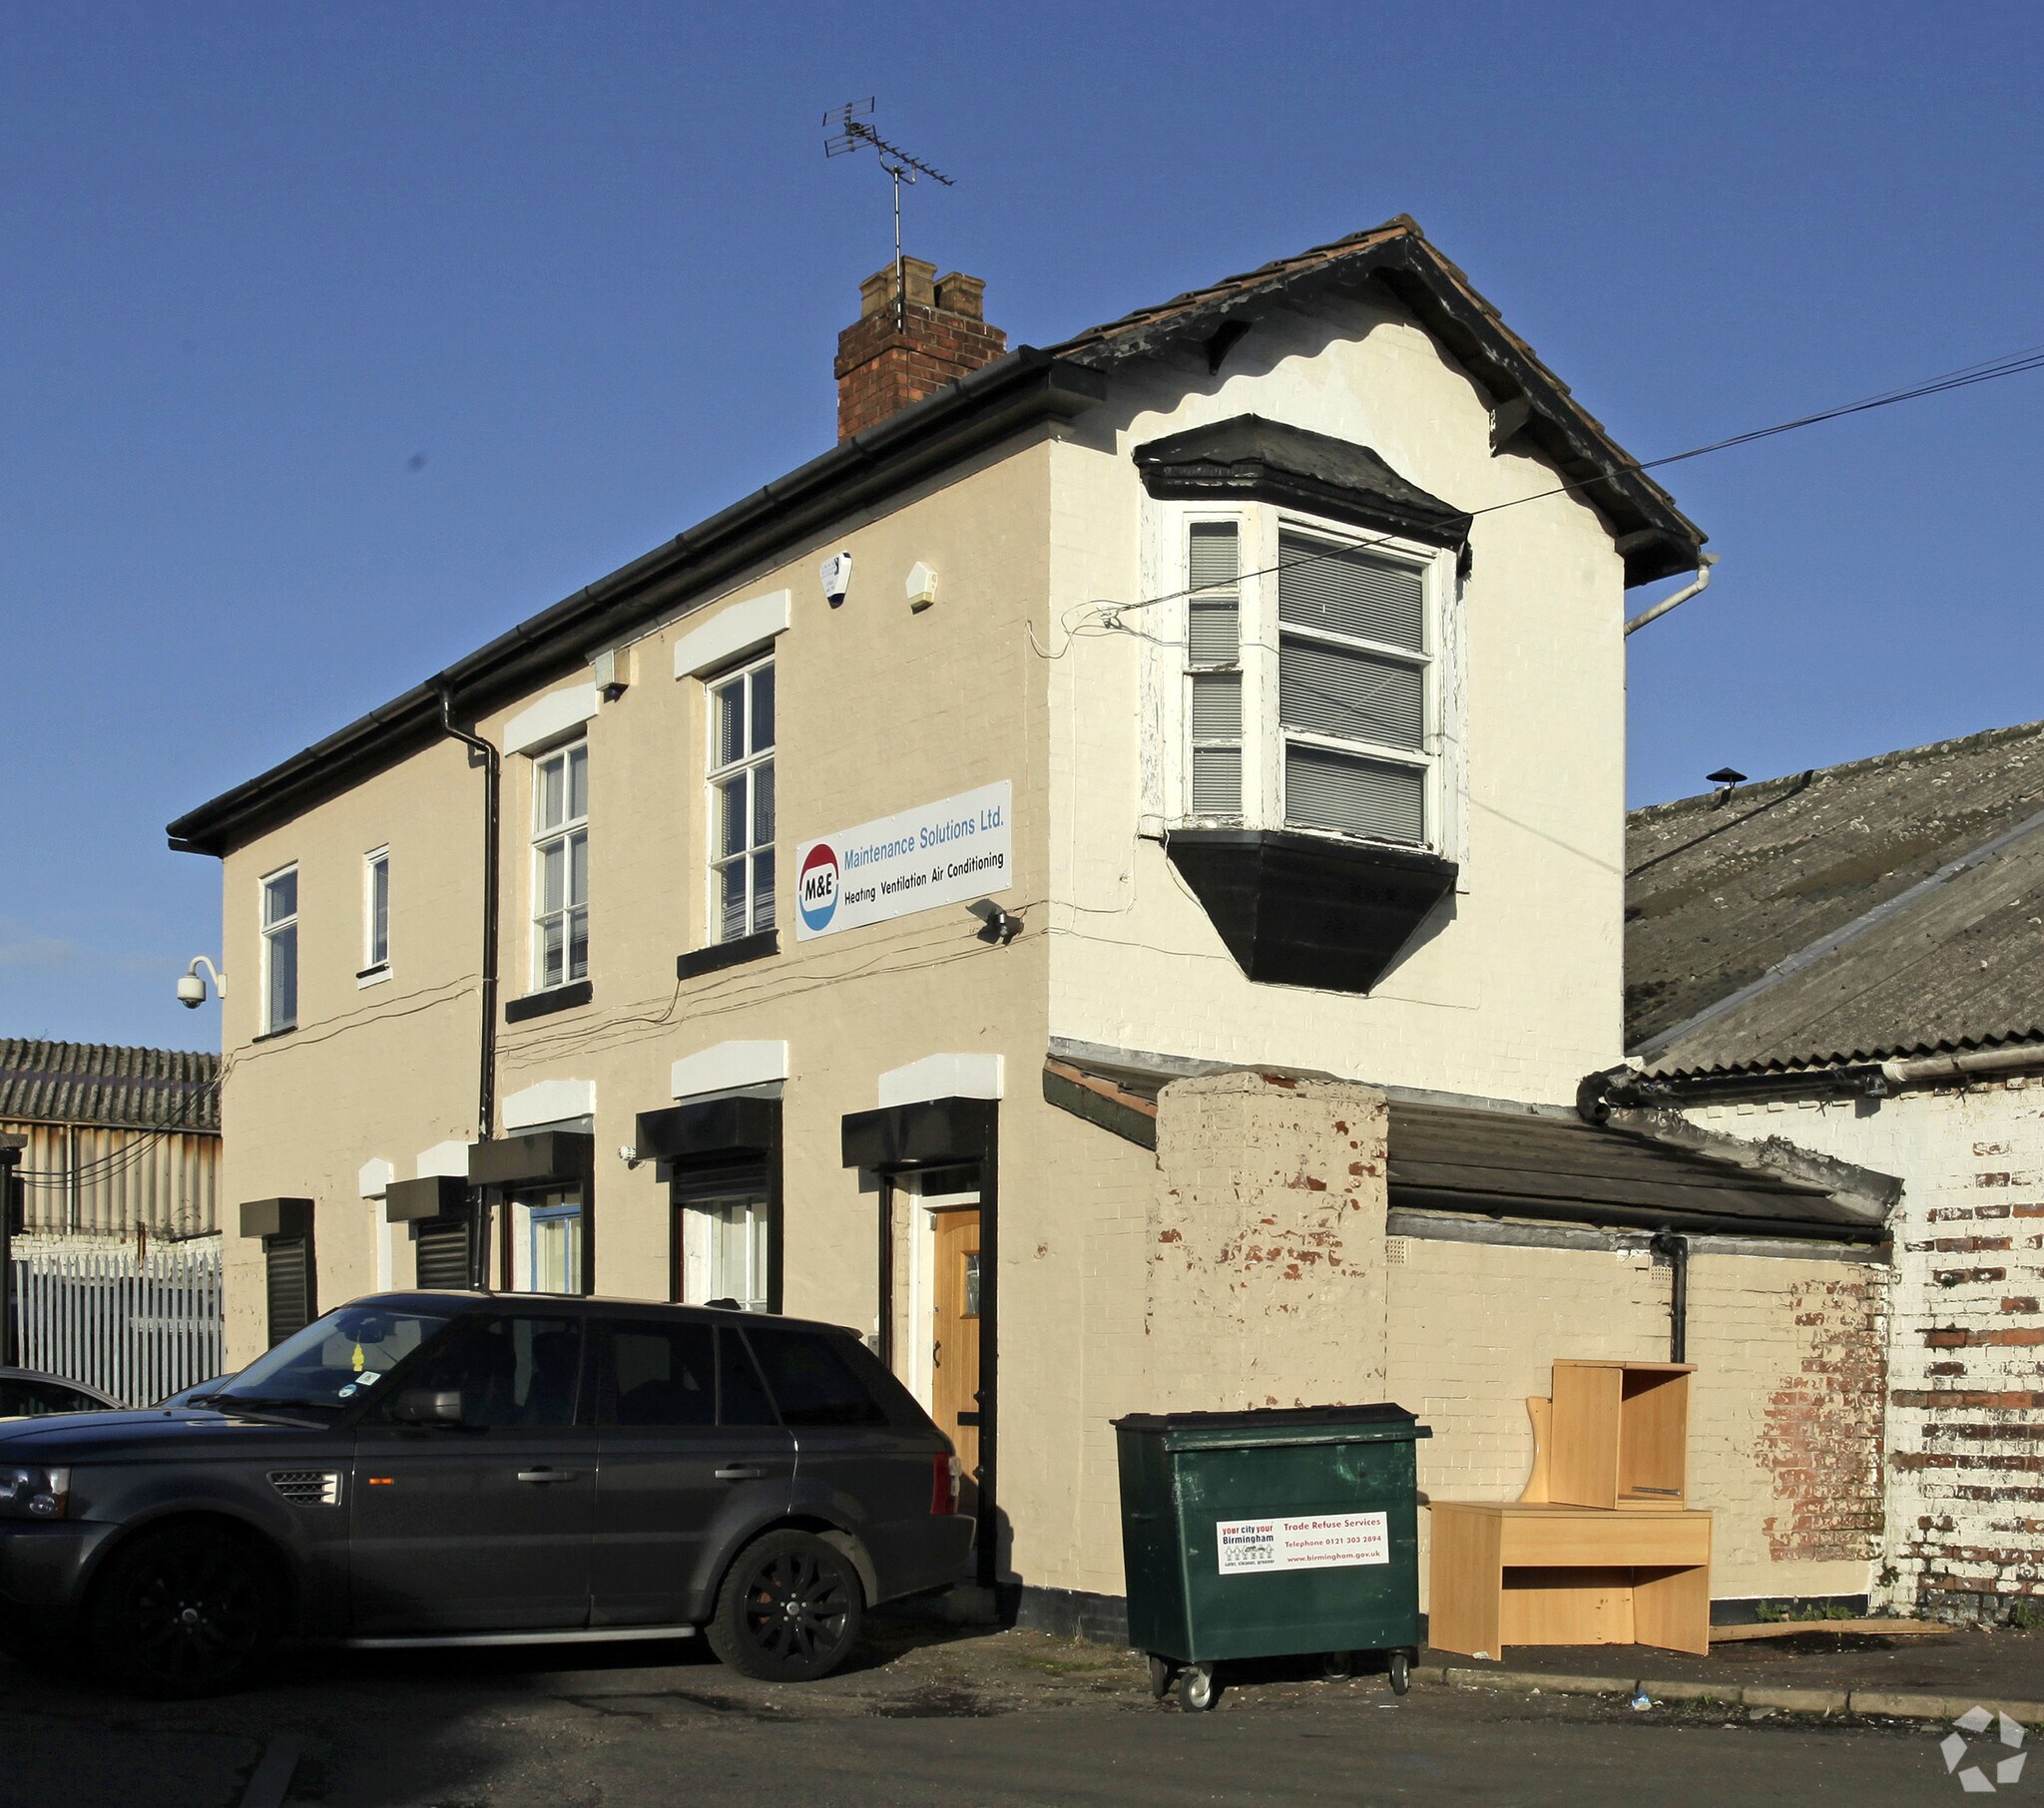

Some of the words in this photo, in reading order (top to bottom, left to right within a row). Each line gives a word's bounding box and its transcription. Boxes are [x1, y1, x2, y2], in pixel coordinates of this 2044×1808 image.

[844, 835, 914, 871] Maintenance
[920, 818, 975, 849] Solutions
[980, 805, 1004, 831] Ltd.
[844, 886, 875, 906] Heating
[880, 871, 927, 896] Ventilation
[931, 867, 944, 883] Air
[947, 852, 1004, 879] Conditioning
[804, 872, 832, 901] M&E
[1283, 1522, 1309, 1531] Trade
[1311, 1521, 1341, 1530] Refuse
[1344, 1518, 1381, 1528] Services
[1223, 1527, 1240, 1536] your
[1223, 1535, 1274, 1545] Birmingham
[1286, 1550, 1380, 1563] www.birmingham.gov.uk
